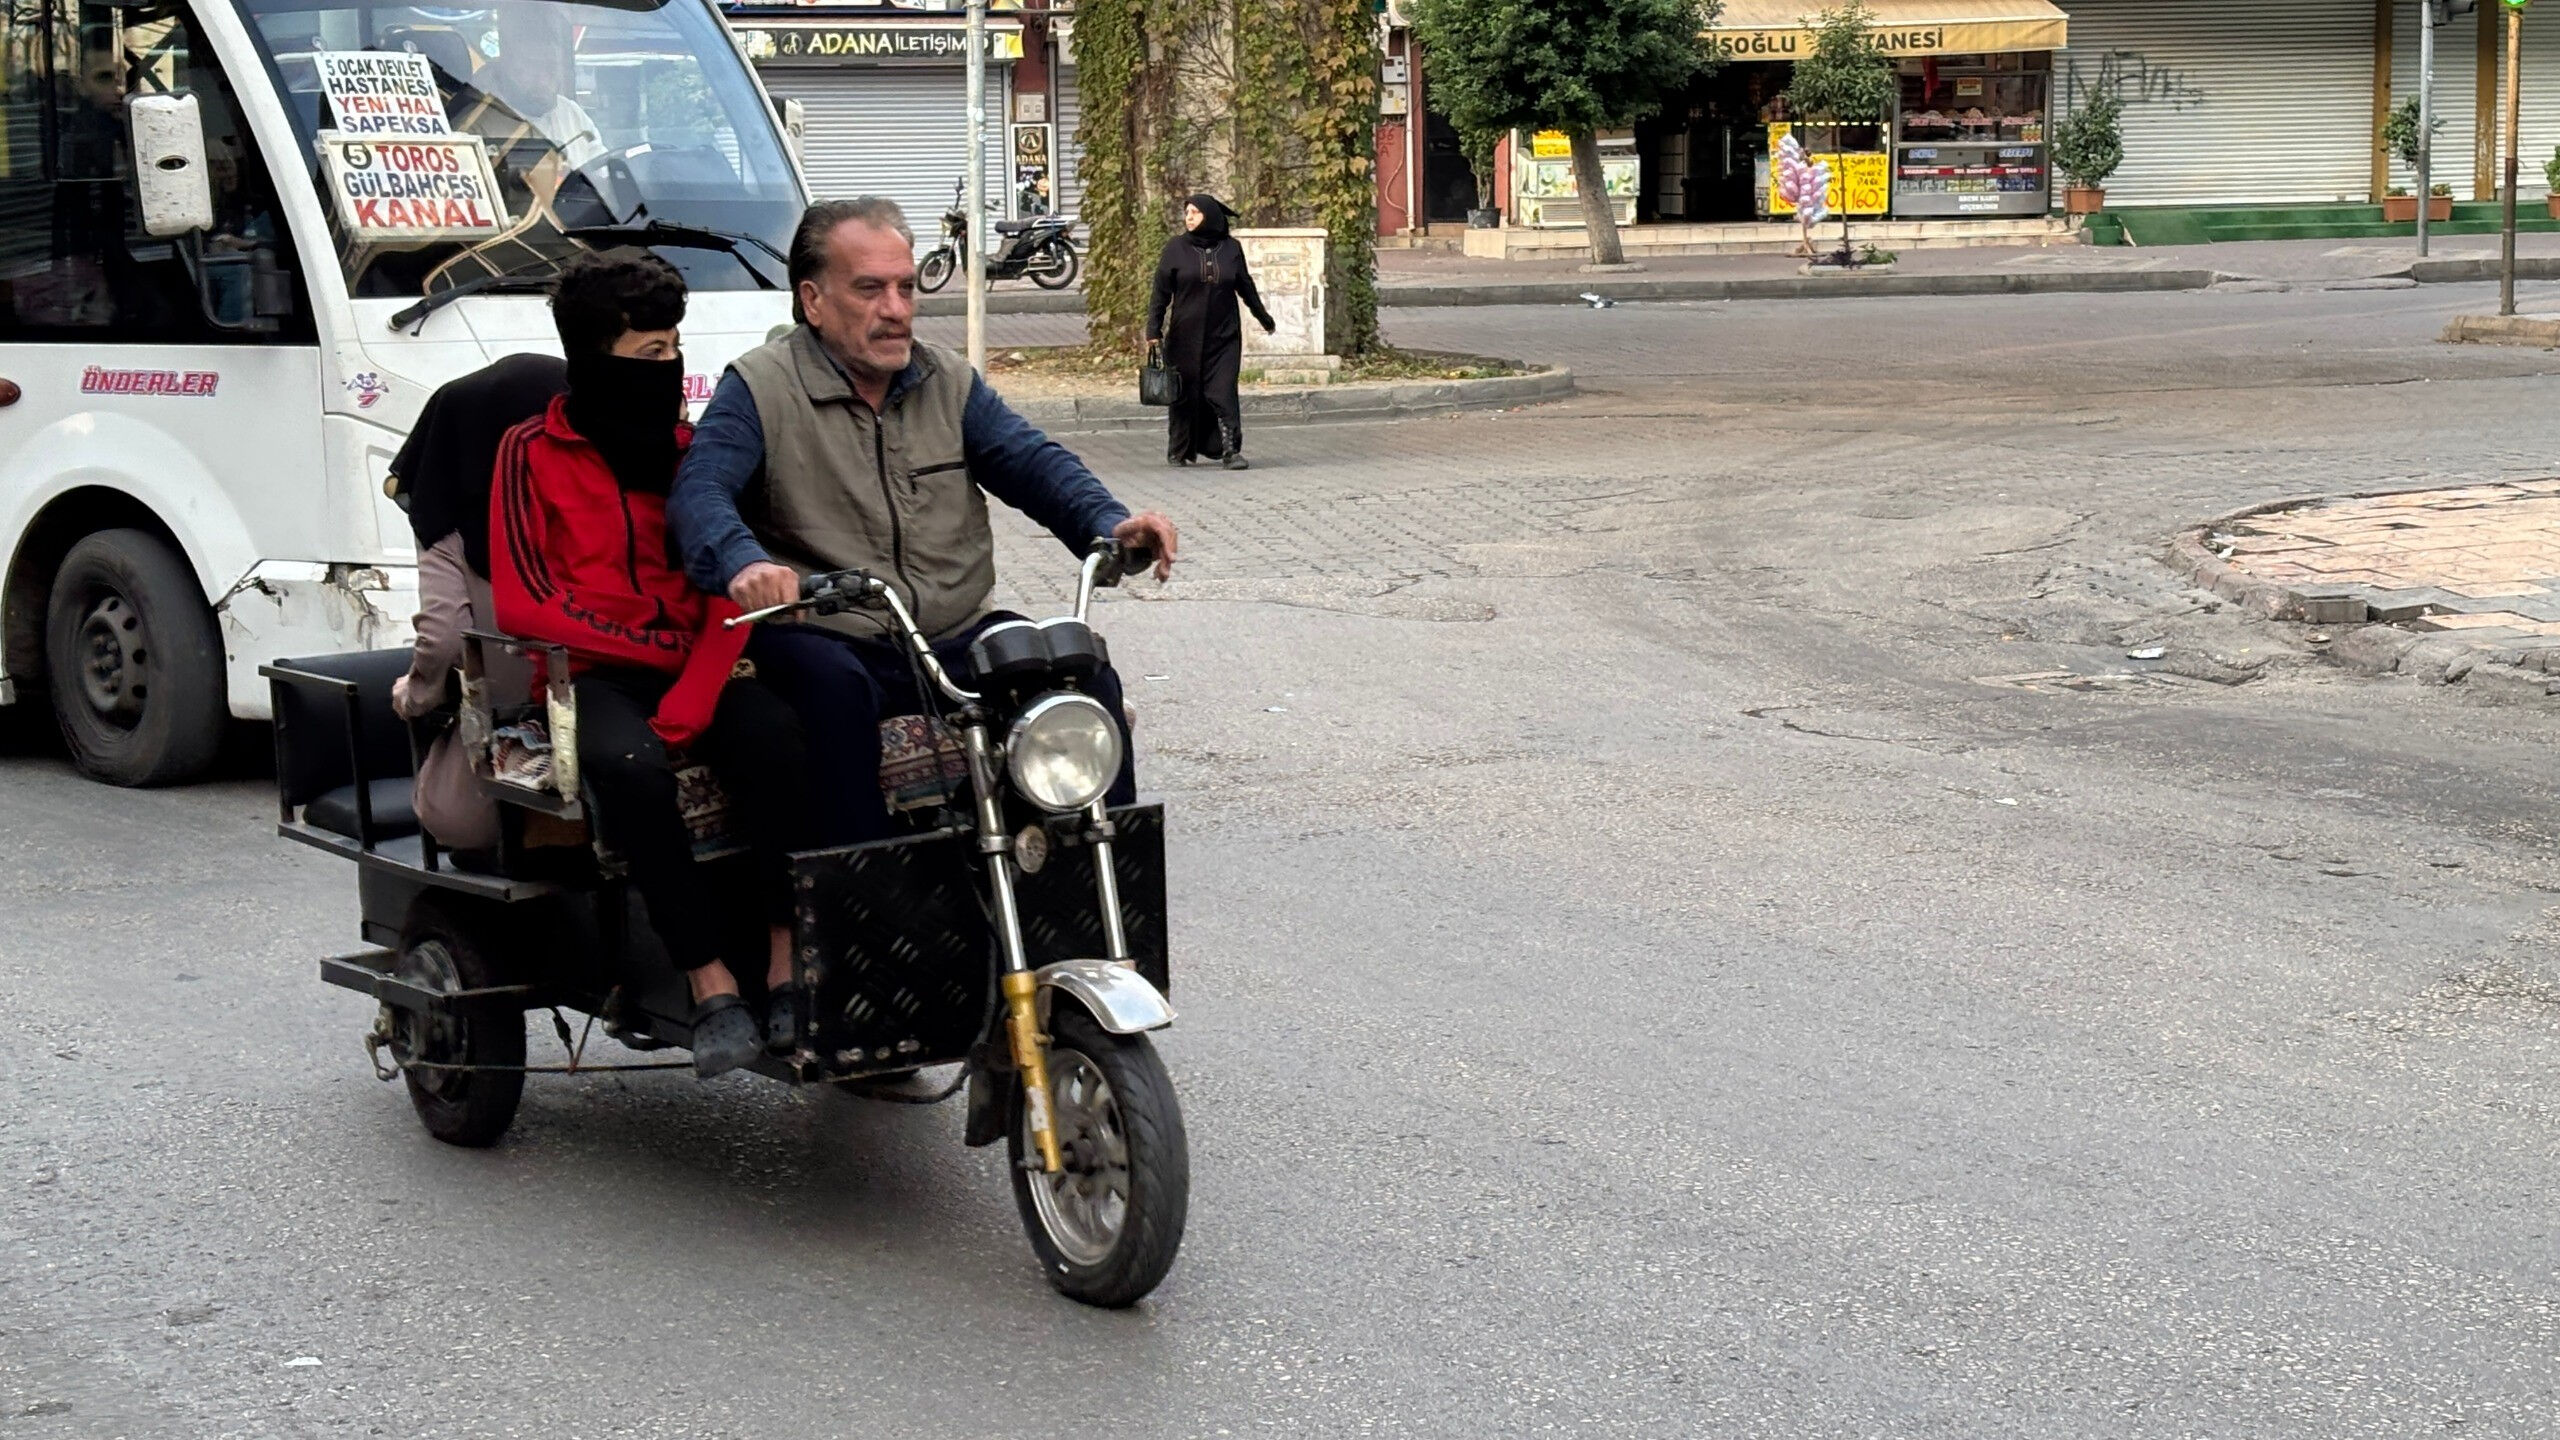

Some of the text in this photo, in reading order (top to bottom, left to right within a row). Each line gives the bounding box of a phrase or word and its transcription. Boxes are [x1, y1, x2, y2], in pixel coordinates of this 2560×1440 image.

[807, 32, 893, 55] ADANA
[326, 59, 424, 77] 5 OCAK DEVLET
[395, 97, 441, 116] HAL
[342, 115, 447, 136] SAPEKSA
[375, 145, 460, 173] TOROS
[353, 198, 493, 229] KANAL
[80, 365, 219, 397] ÖNDERLER
